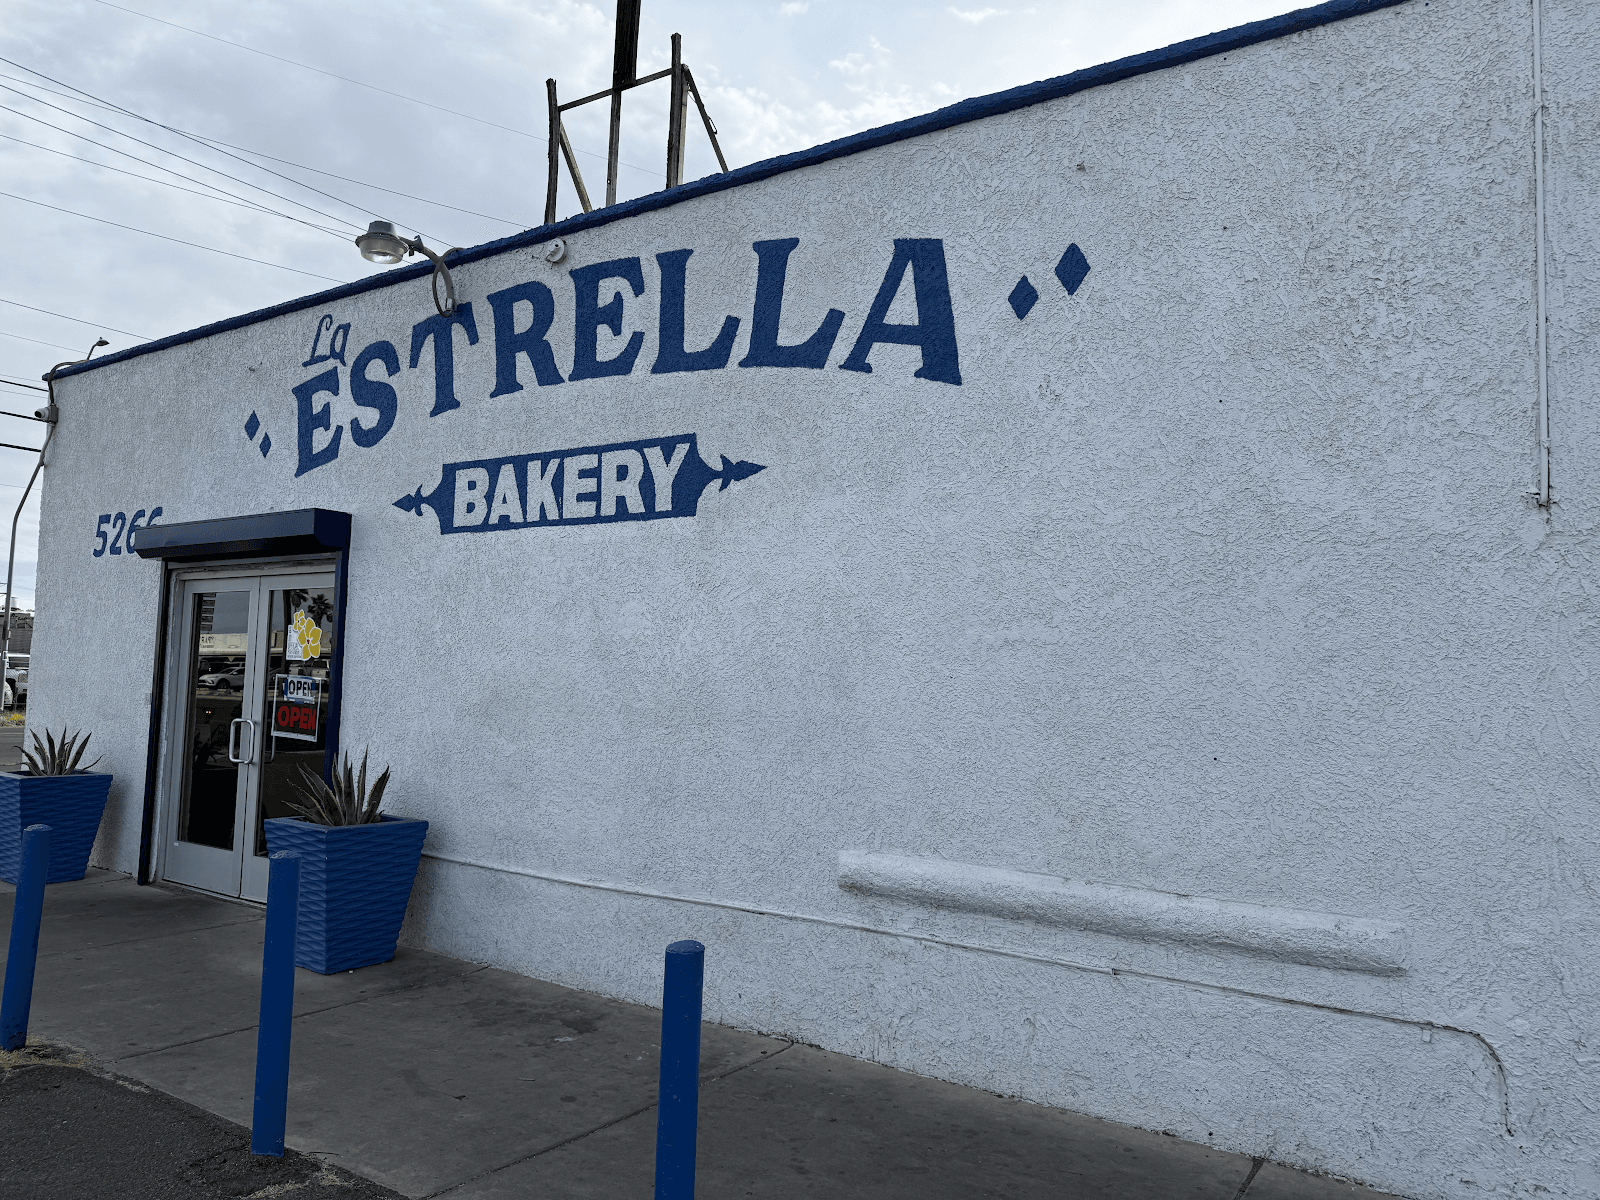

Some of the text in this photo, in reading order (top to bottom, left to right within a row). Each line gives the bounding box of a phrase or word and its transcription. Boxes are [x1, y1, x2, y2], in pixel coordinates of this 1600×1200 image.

[292, 238, 961, 478] ESTRELLA
[302, 313, 351, 367] La
[453, 442, 690, 528] BAKERY
[277, 705, 317, 730] OPEN
